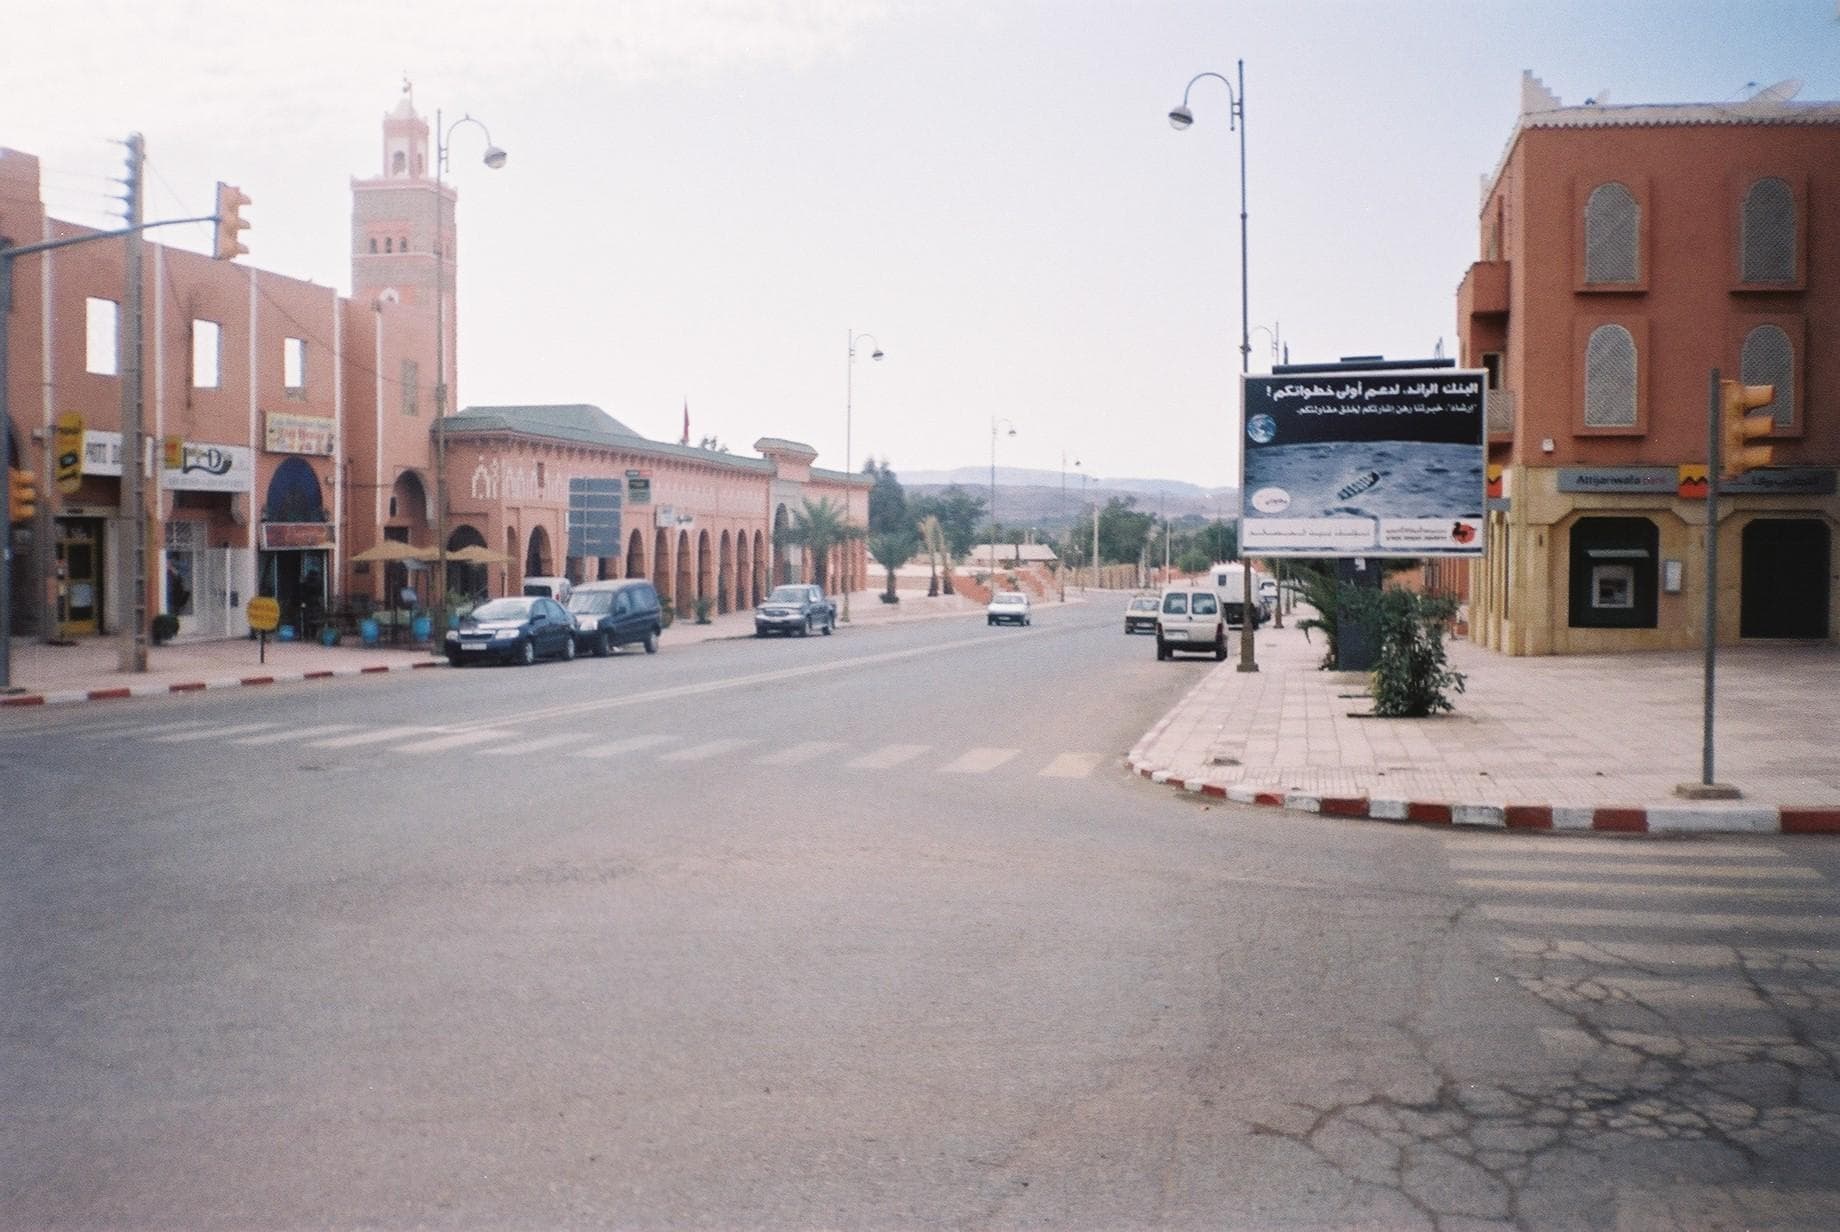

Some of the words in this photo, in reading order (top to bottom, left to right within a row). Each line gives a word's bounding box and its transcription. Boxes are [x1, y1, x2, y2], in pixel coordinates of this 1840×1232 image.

[1336, 380, 1363, 399] أولى
[1364, 383, 1400, 400] لدعم
[1442, 382, 1479, 397] البنك
